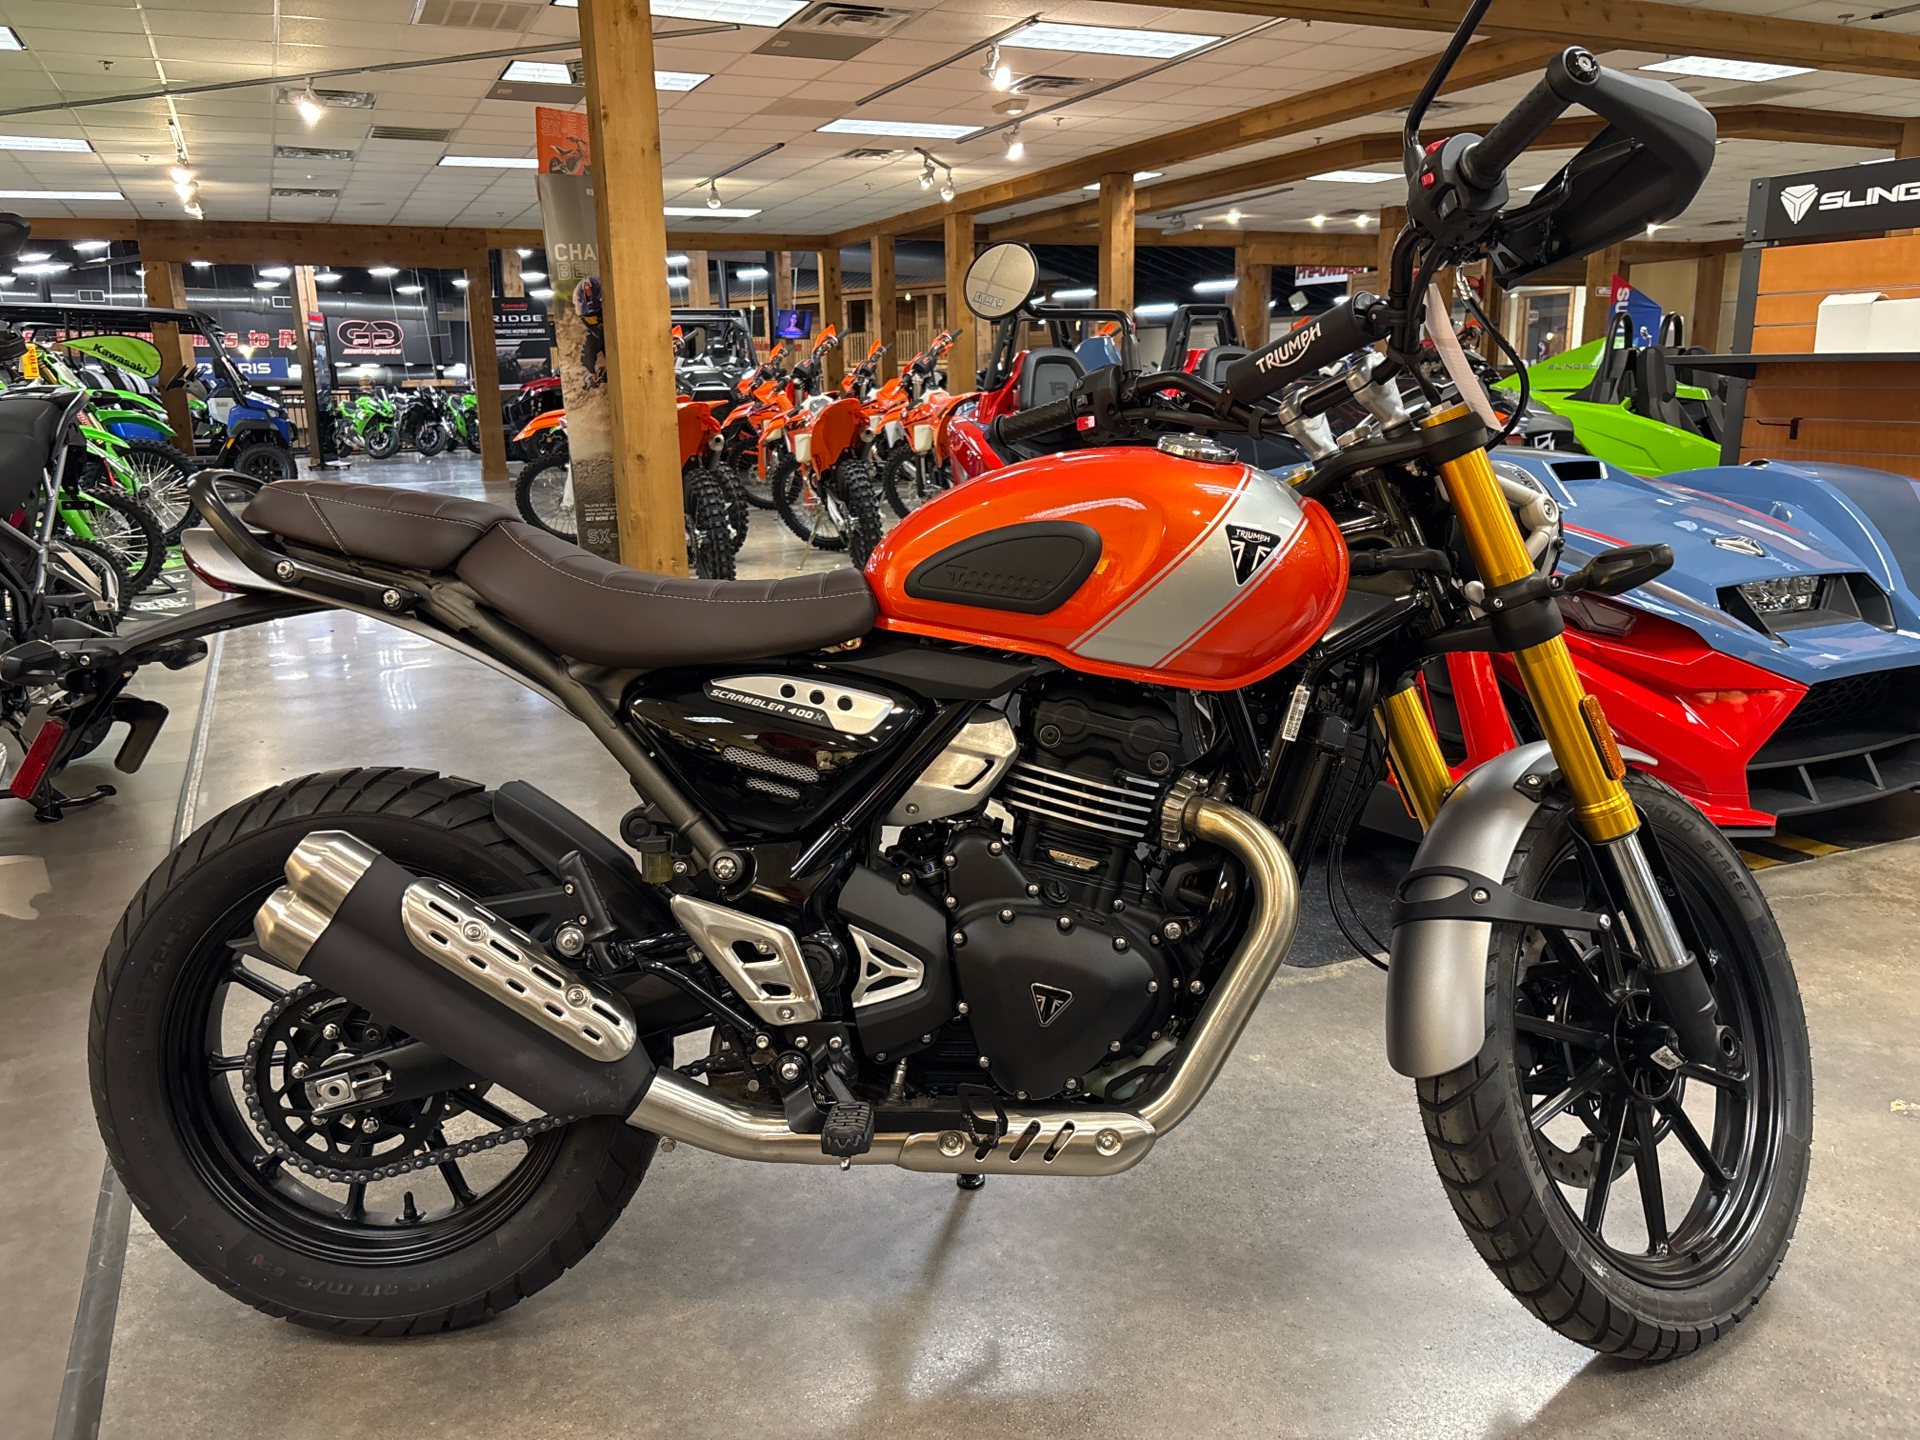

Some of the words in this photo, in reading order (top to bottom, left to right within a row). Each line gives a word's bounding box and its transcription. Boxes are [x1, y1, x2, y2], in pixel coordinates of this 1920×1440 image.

[1819, 181, 1920, 211] SLING
[554, 243, 598, 261] CHA
[92, 342, 149, 375] Kawasaki
[342, 347, 402, 356] motorsports
[1255, 322, 1322, 374] TRIUMPH
[1235, 528, 1271, 543] TRIUMPH
[709, 688, 786, 713] SCRAMBLER
[1699, 838, 1754, 903] STREET
